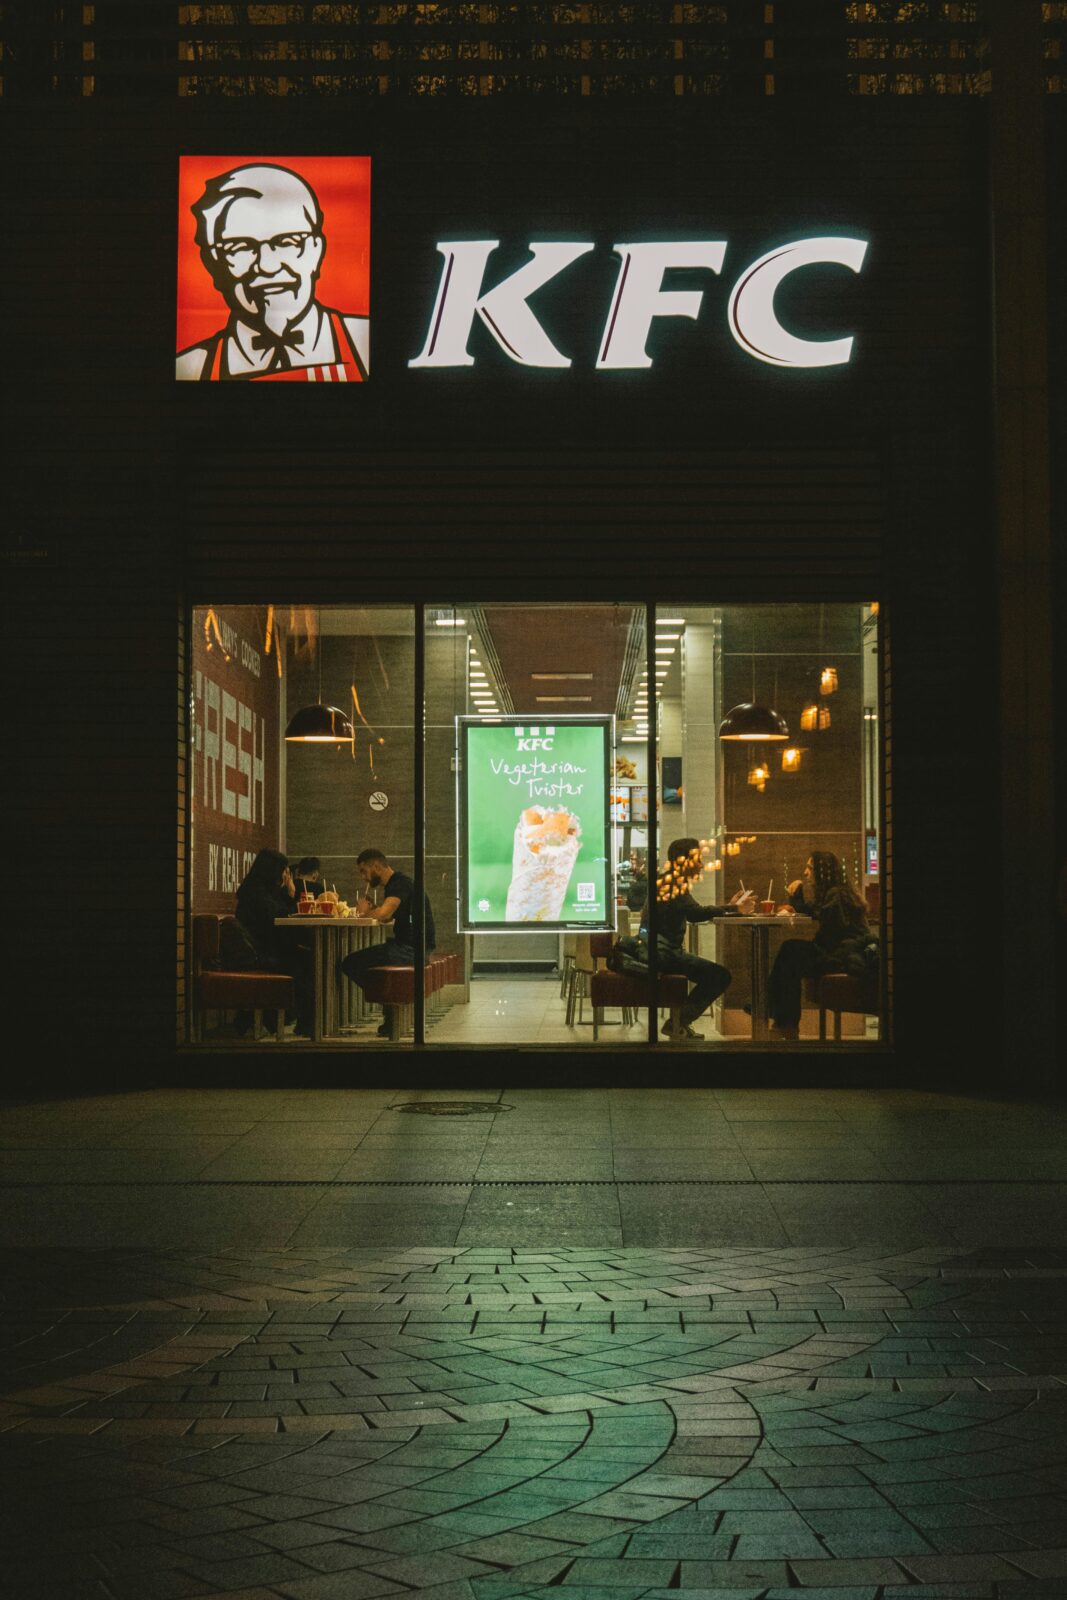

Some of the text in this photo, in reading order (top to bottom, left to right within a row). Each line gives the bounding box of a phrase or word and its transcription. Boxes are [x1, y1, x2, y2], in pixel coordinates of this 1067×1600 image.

[407, 236, 869, 370] KFC
[516, 738, 554, 752] KFC
[208, 843, 219, 892] BY
[222, 846, 241, 894] REAL
